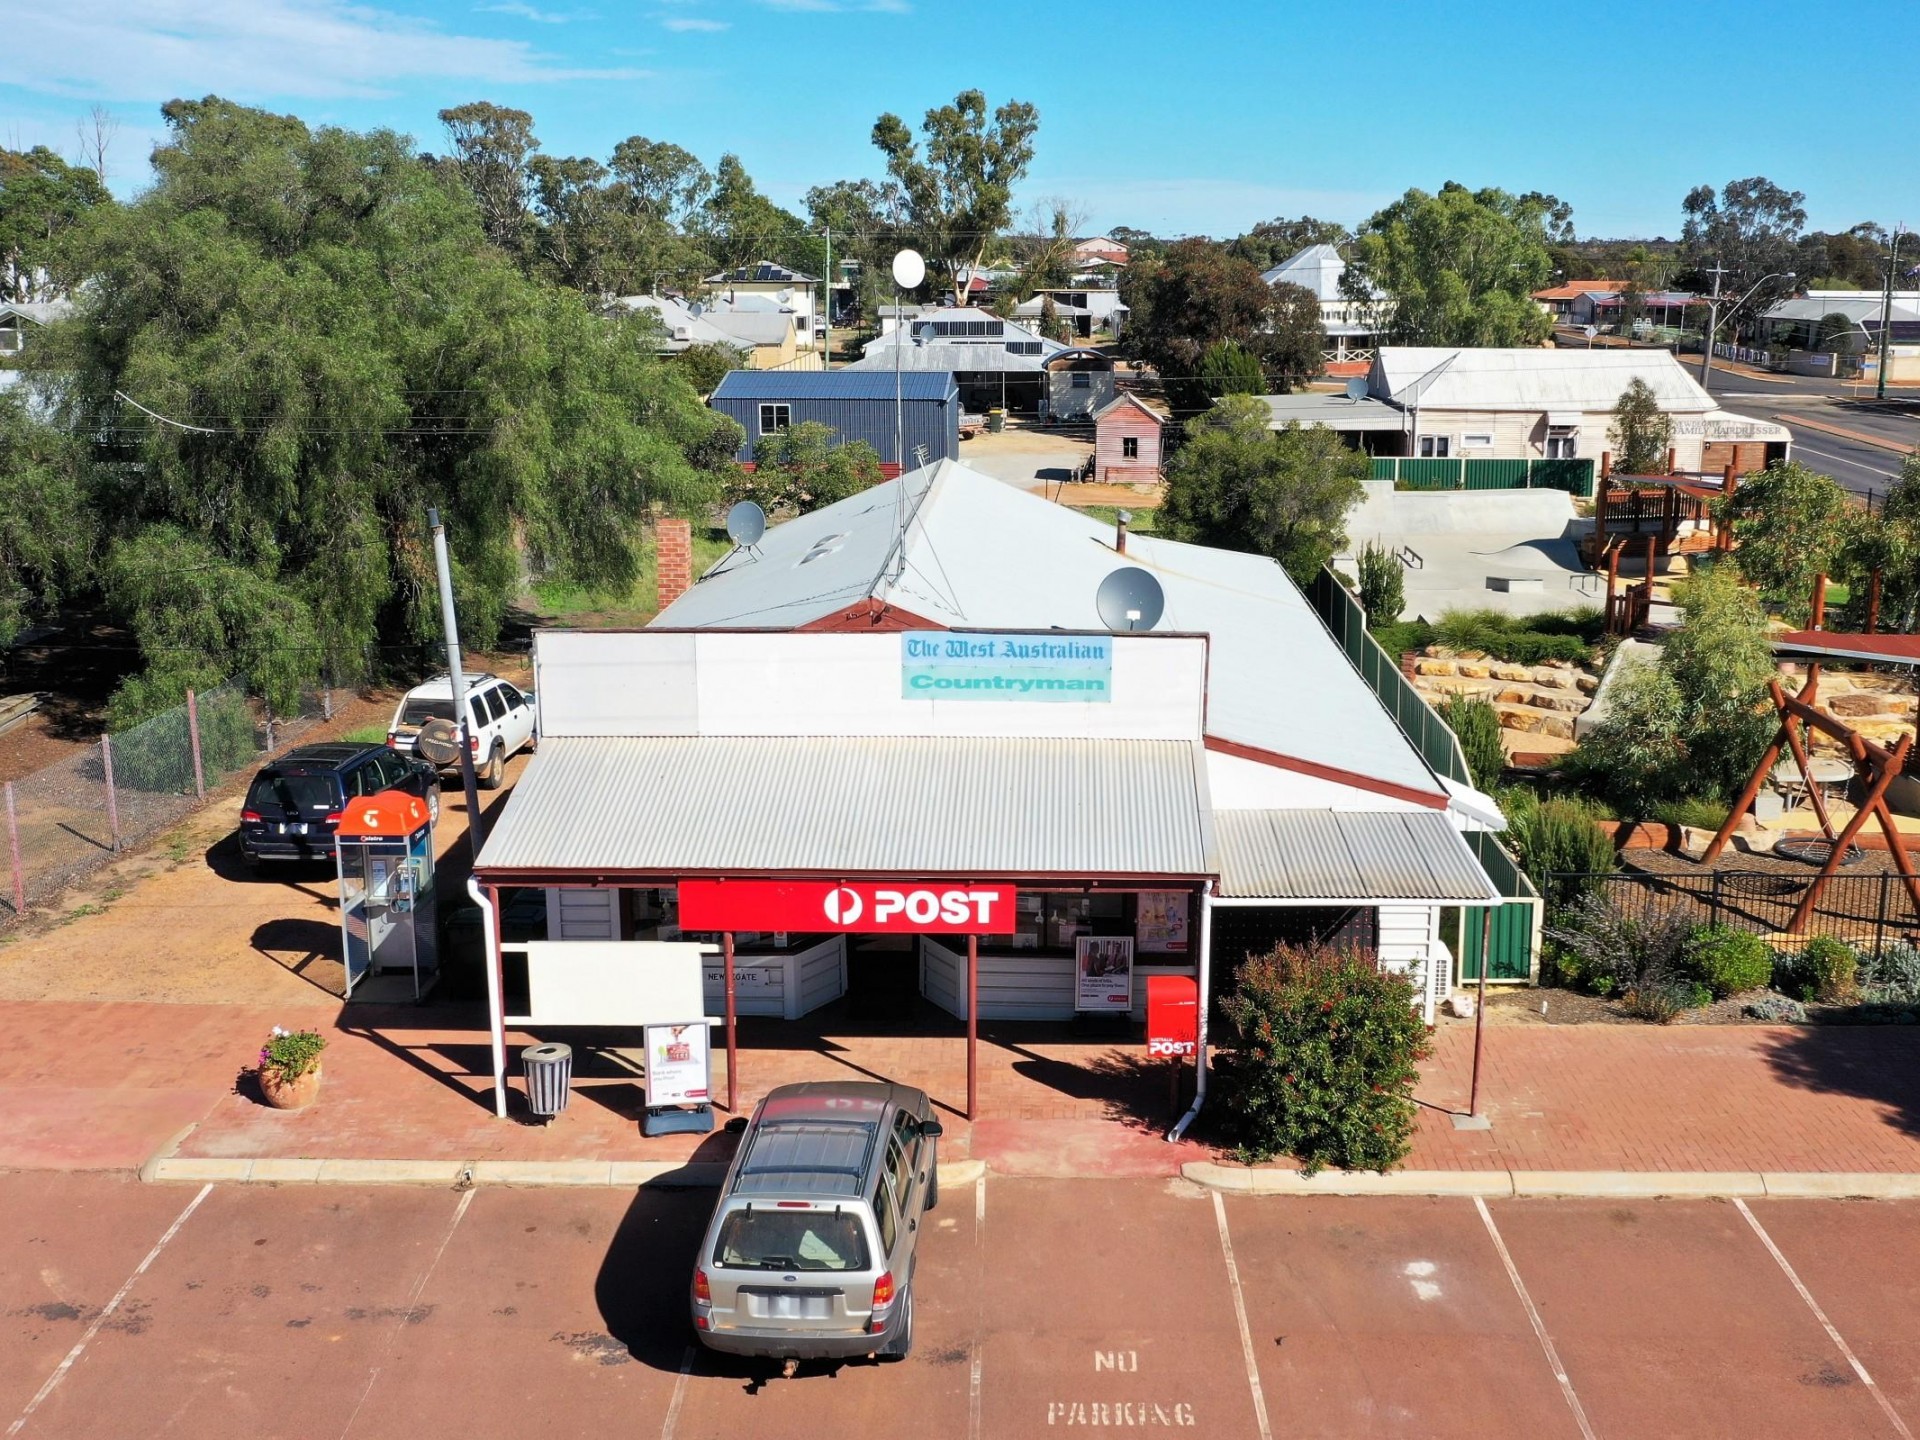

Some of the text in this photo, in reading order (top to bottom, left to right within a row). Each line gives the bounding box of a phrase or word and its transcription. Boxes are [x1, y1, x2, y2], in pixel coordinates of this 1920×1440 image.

[1673, 426, 1782, 435] FAMILY HAIRDRESSER
[907, 639, 1105, 660] The West Australian
[910, 675, 1105, 692] Countryman
[876, 890, 999, 924] POST
[708, 973, 757, 981] NEWGATE
[1149, 1041, 1194, 1055] POST
[1094, 1350, 1138, 1372] NO
[1047, 1402, 1196, 1427] PARKING
